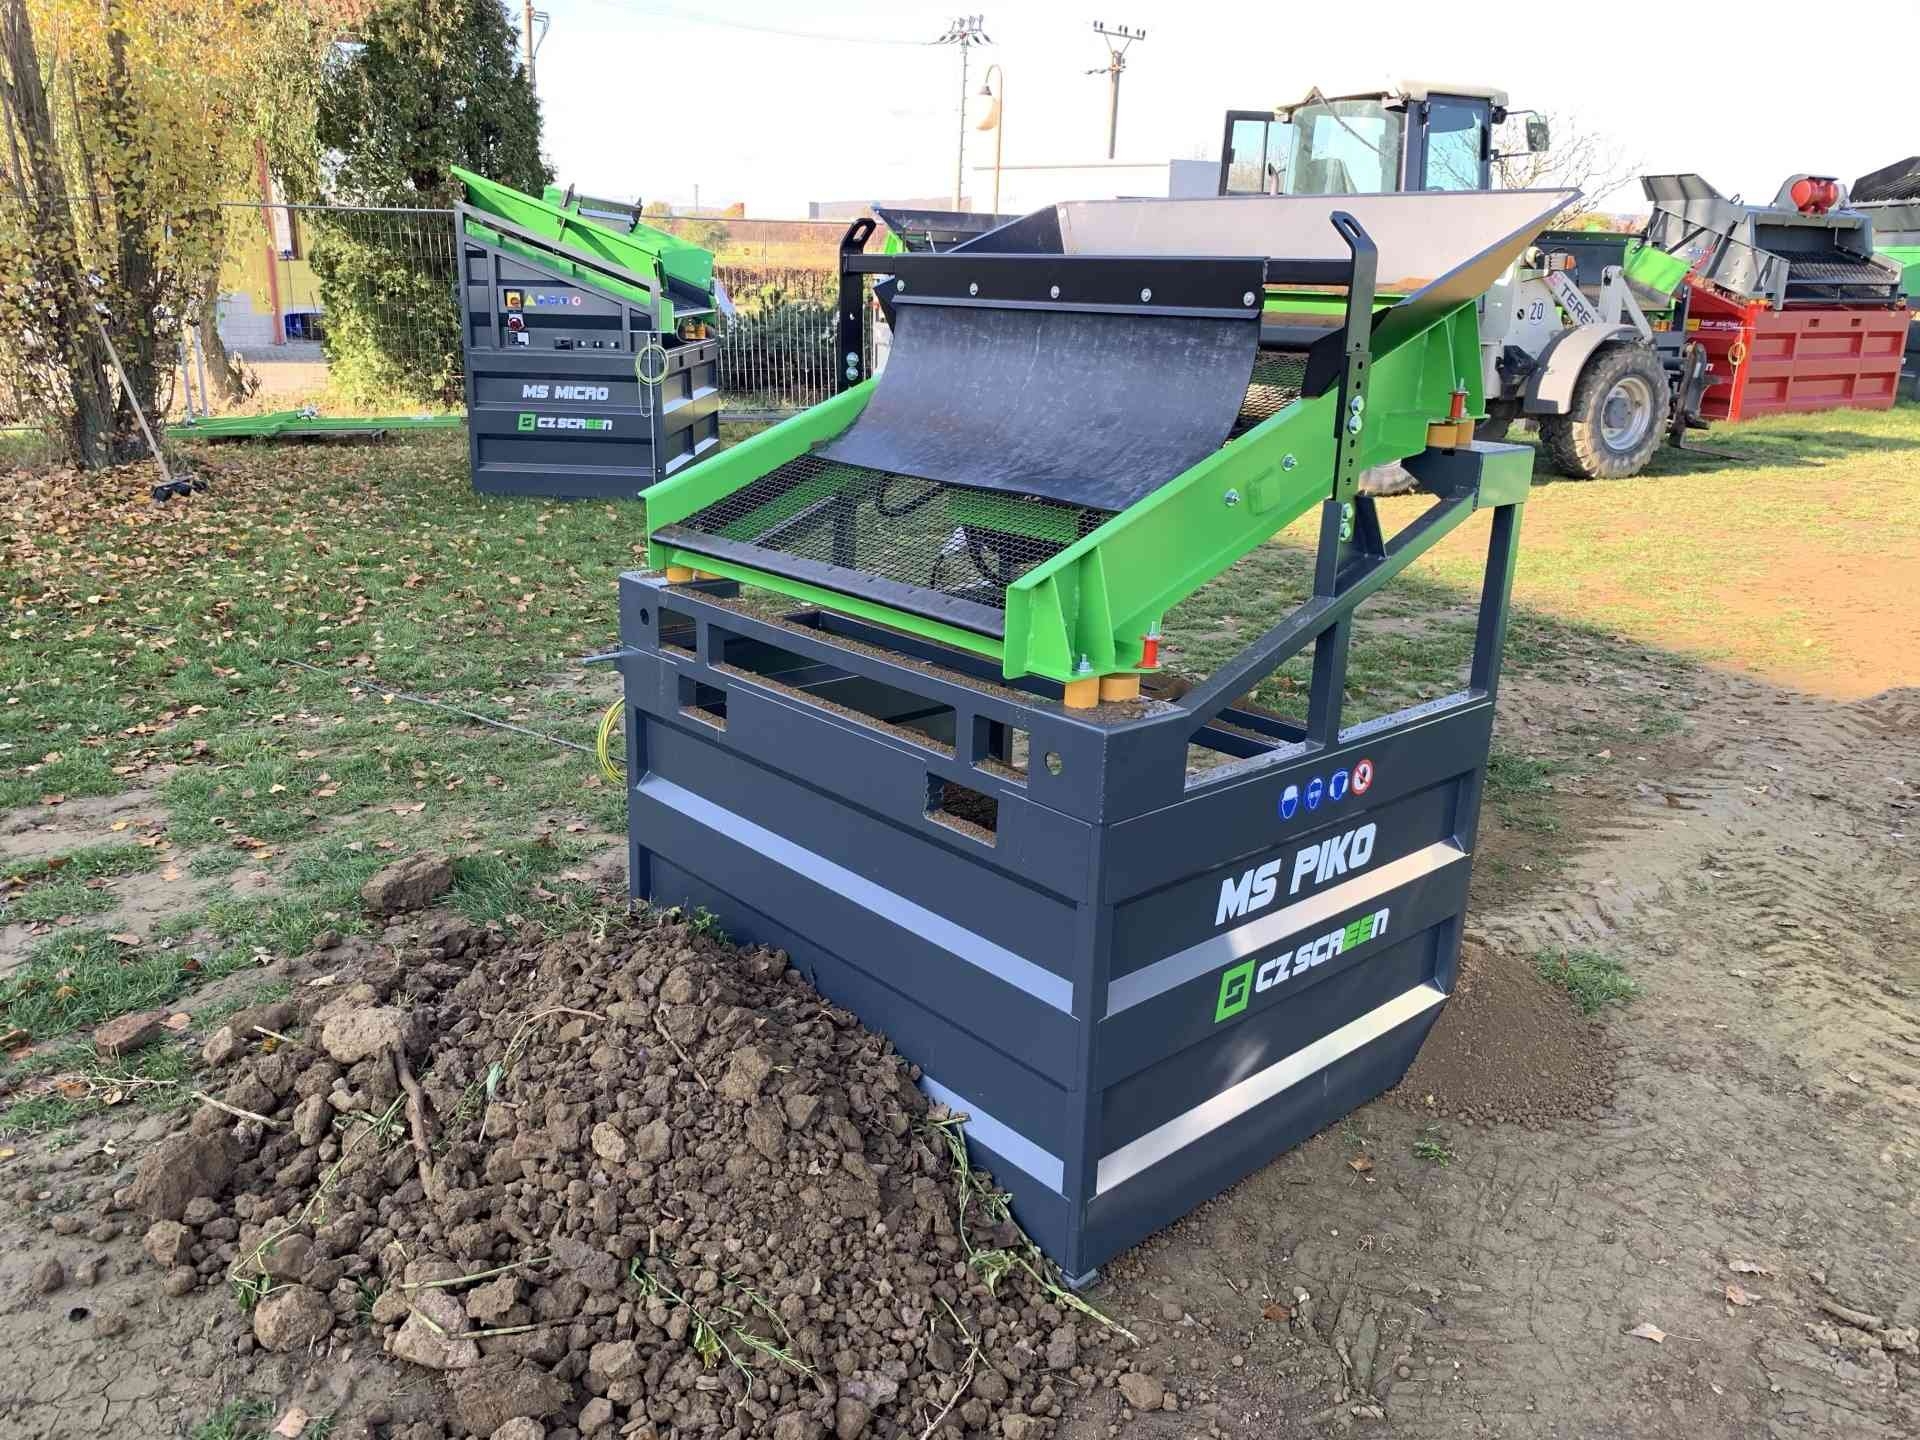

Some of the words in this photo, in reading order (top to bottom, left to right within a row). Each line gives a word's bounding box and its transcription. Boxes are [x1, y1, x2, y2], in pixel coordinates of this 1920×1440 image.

[1530, 302, 1544, 320] 20
[1561, 283, 1595, 326] TERE
[522, 384, 549, 399] MS
[554, 385, 609, 400] MICRO
[1214, 858, 1282, 927] MS
[1289, 822, 1377, 896] PIKO
